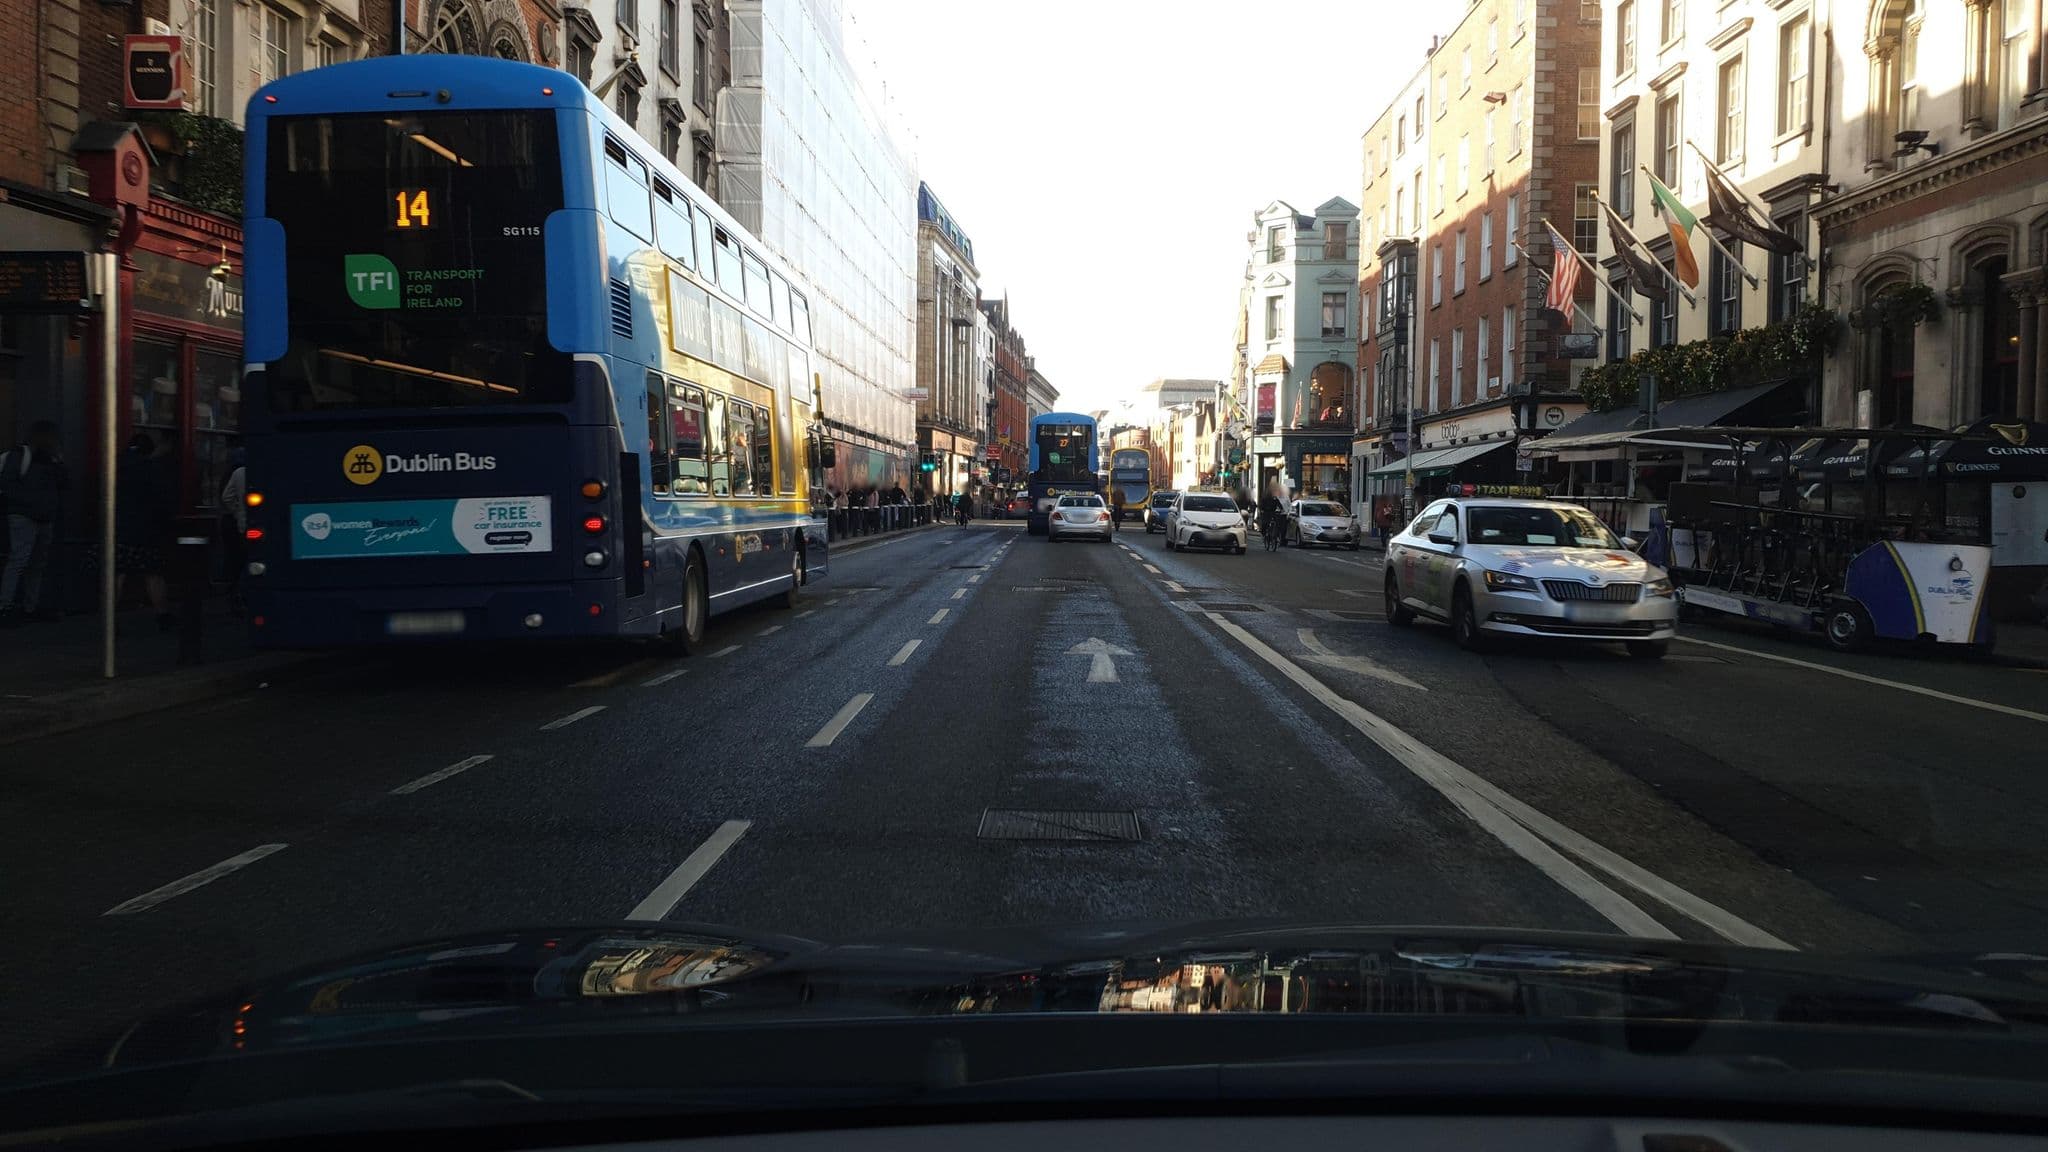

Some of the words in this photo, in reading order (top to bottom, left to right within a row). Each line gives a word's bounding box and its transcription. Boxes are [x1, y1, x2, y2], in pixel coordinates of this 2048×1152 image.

[396, 190, 430, 227] 14
[503, 226, 541, 236] SG115
[406, 269, 485, 281] TRANSPORT
[352, 271, 393, 292] TFI
[406, 284, 433, 294] FOR
[406, 297, 463, 309] IRELAND
[386, 453, 452, 473] Dublin
[455, 452, 496, 470] Bus
[1955, 462, 2000, 472] GUINNESS
[1482, 485, 1508, 495] TAXI
[487, 506, 528, 521] FREE
[493, 520, 543, 529] insurance
